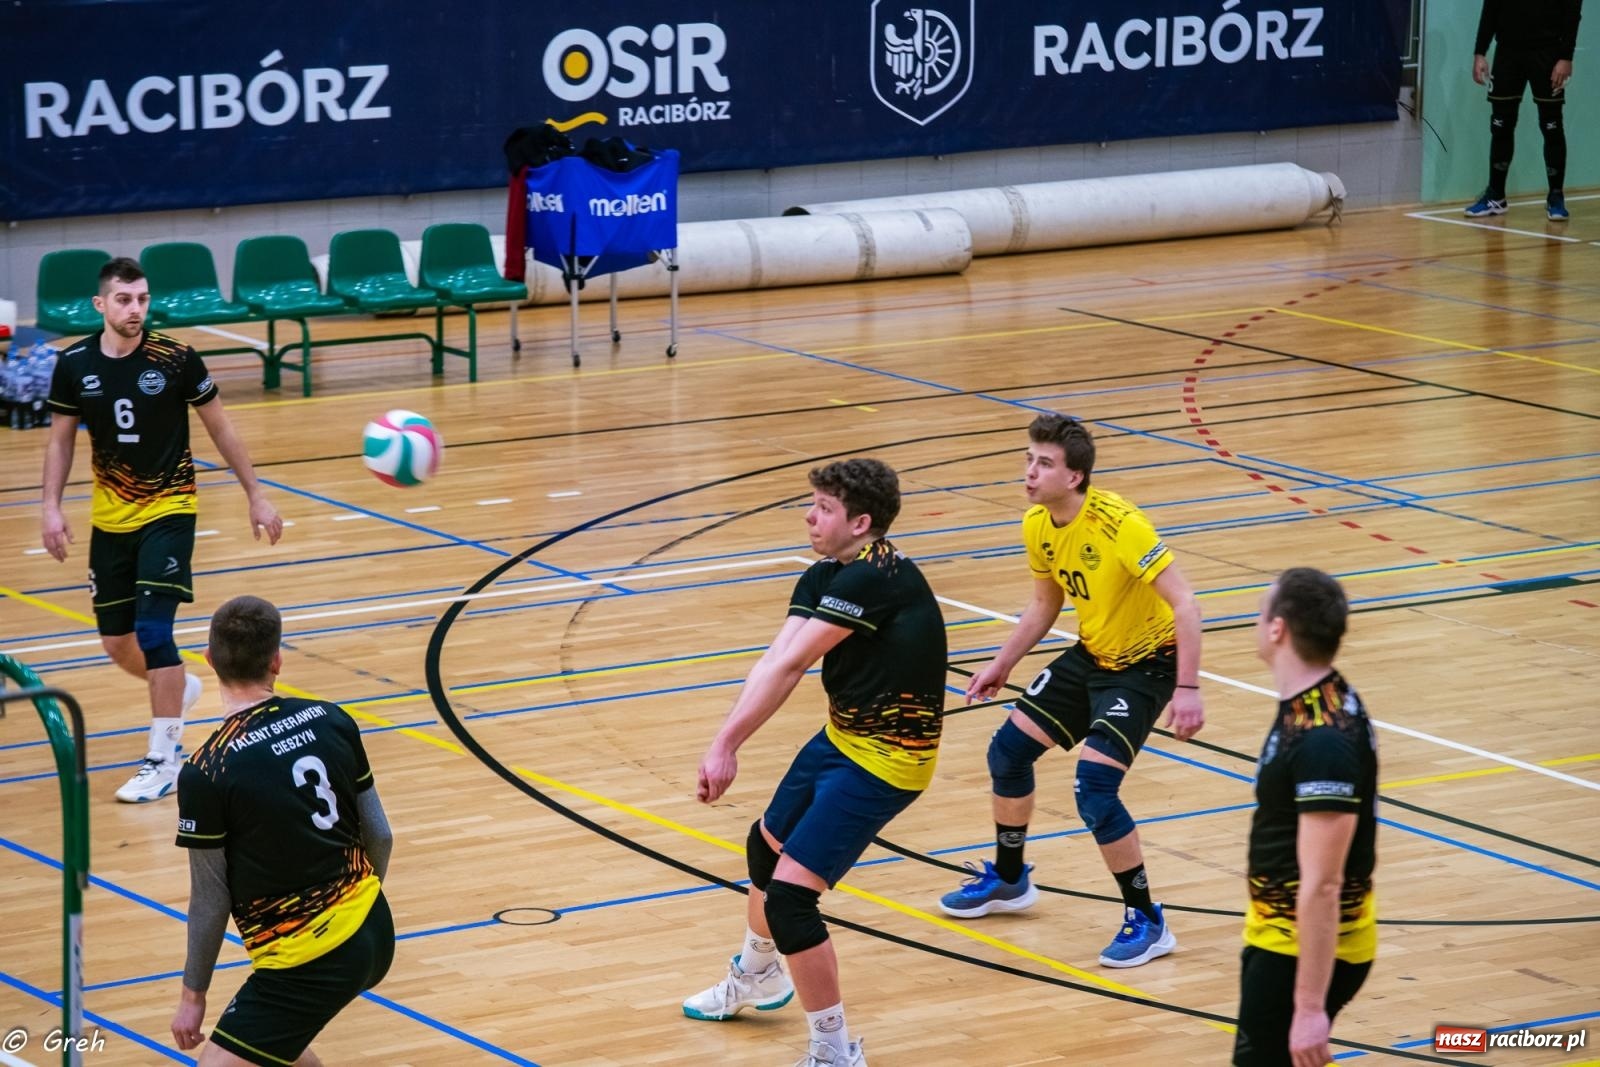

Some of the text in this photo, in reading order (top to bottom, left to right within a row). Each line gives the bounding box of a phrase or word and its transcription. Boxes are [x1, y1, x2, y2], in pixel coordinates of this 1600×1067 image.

[1033, 0, 1324, 76] RACIBÓRZ
[25, 51, 391, 138] RACIBÓRZ
[618, 98, 731, 126] RACIBÓRZ
[589, 192, 666, 217] molten
[114, 398, 135, 429] 6
[1058, 568, 1090, 601] 30
[227, 726, 272, 753] TALENT
[270, 728, 317, 756] CIESZYN
[292, 755, 340, 830] 3
